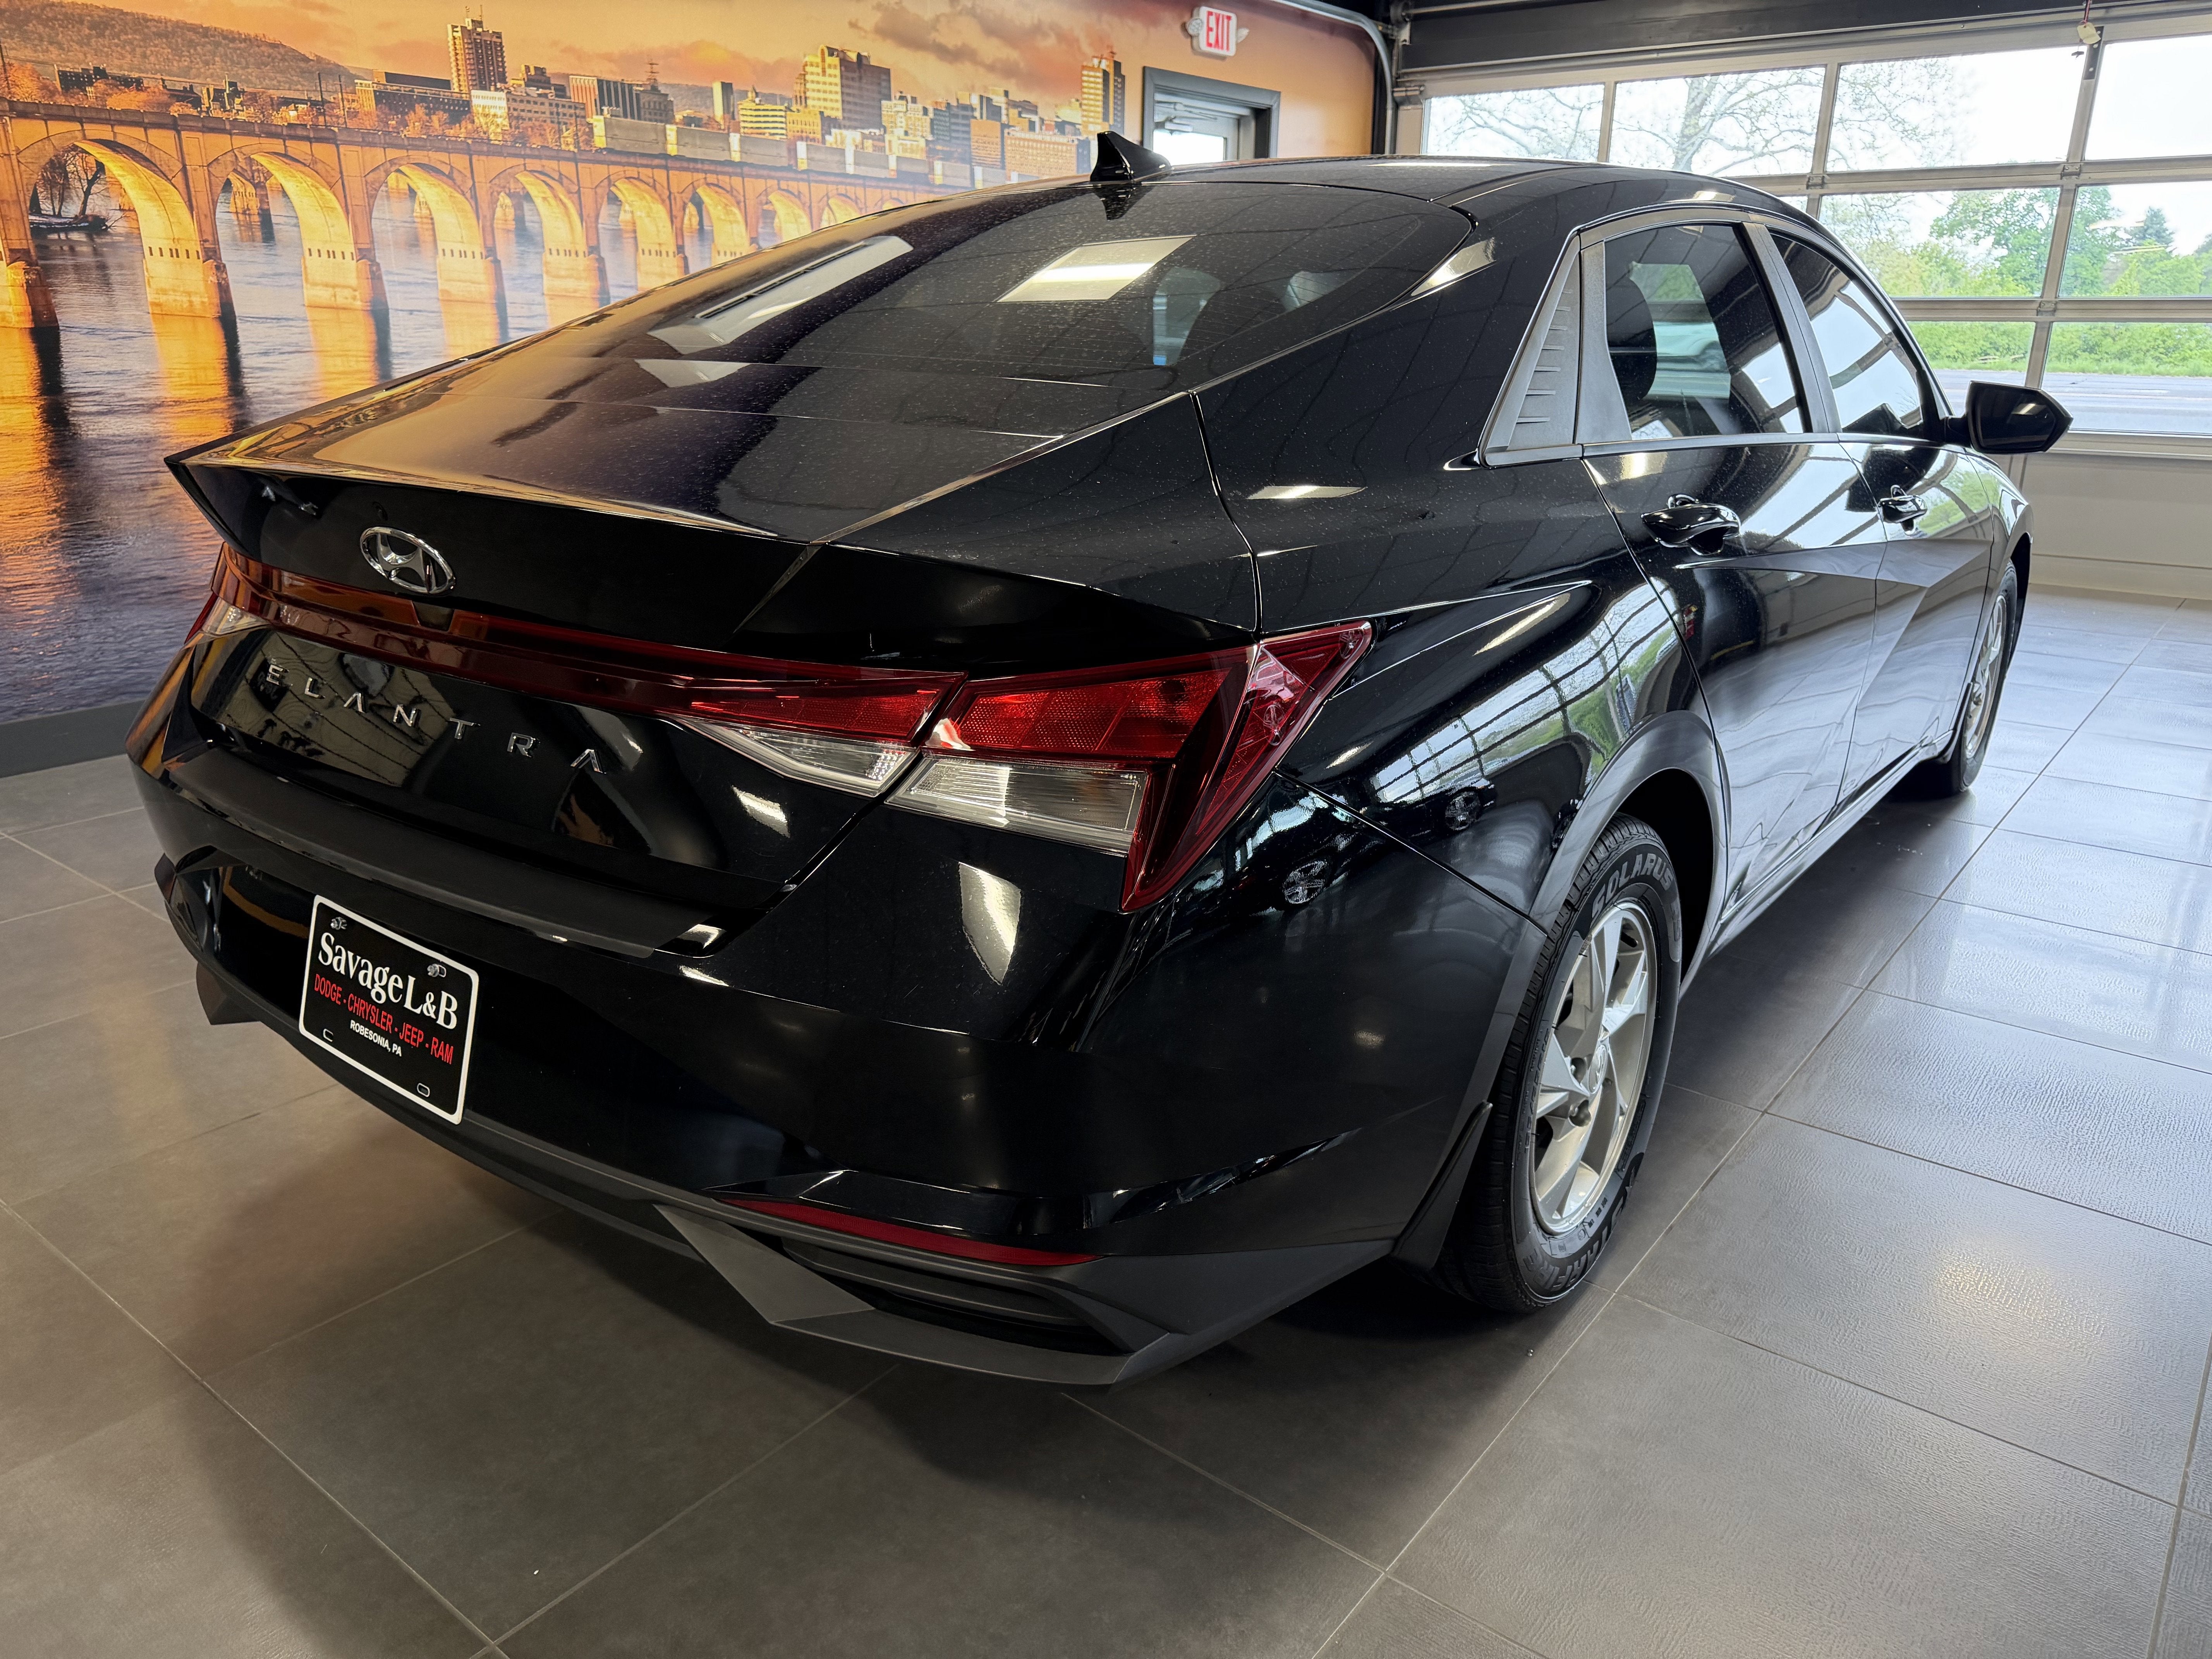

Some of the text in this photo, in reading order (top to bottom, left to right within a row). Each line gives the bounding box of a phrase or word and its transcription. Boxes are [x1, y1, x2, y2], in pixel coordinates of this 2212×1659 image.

[1206, 10, 1232, 52] EXIT
[266, 664, 601, 773] ELANTRA
[1592, 853, 1674, 919] SOLARUS
[314, 974, 342, 1005] DODGE
[348, 993, 393, 1034] CHRYSLER
[399, 1023, 424, 1048] JEEP
[430, 1037, 453, 1064] RAM
[350, 1020, 402, 1057] ROBESONIA, PA
